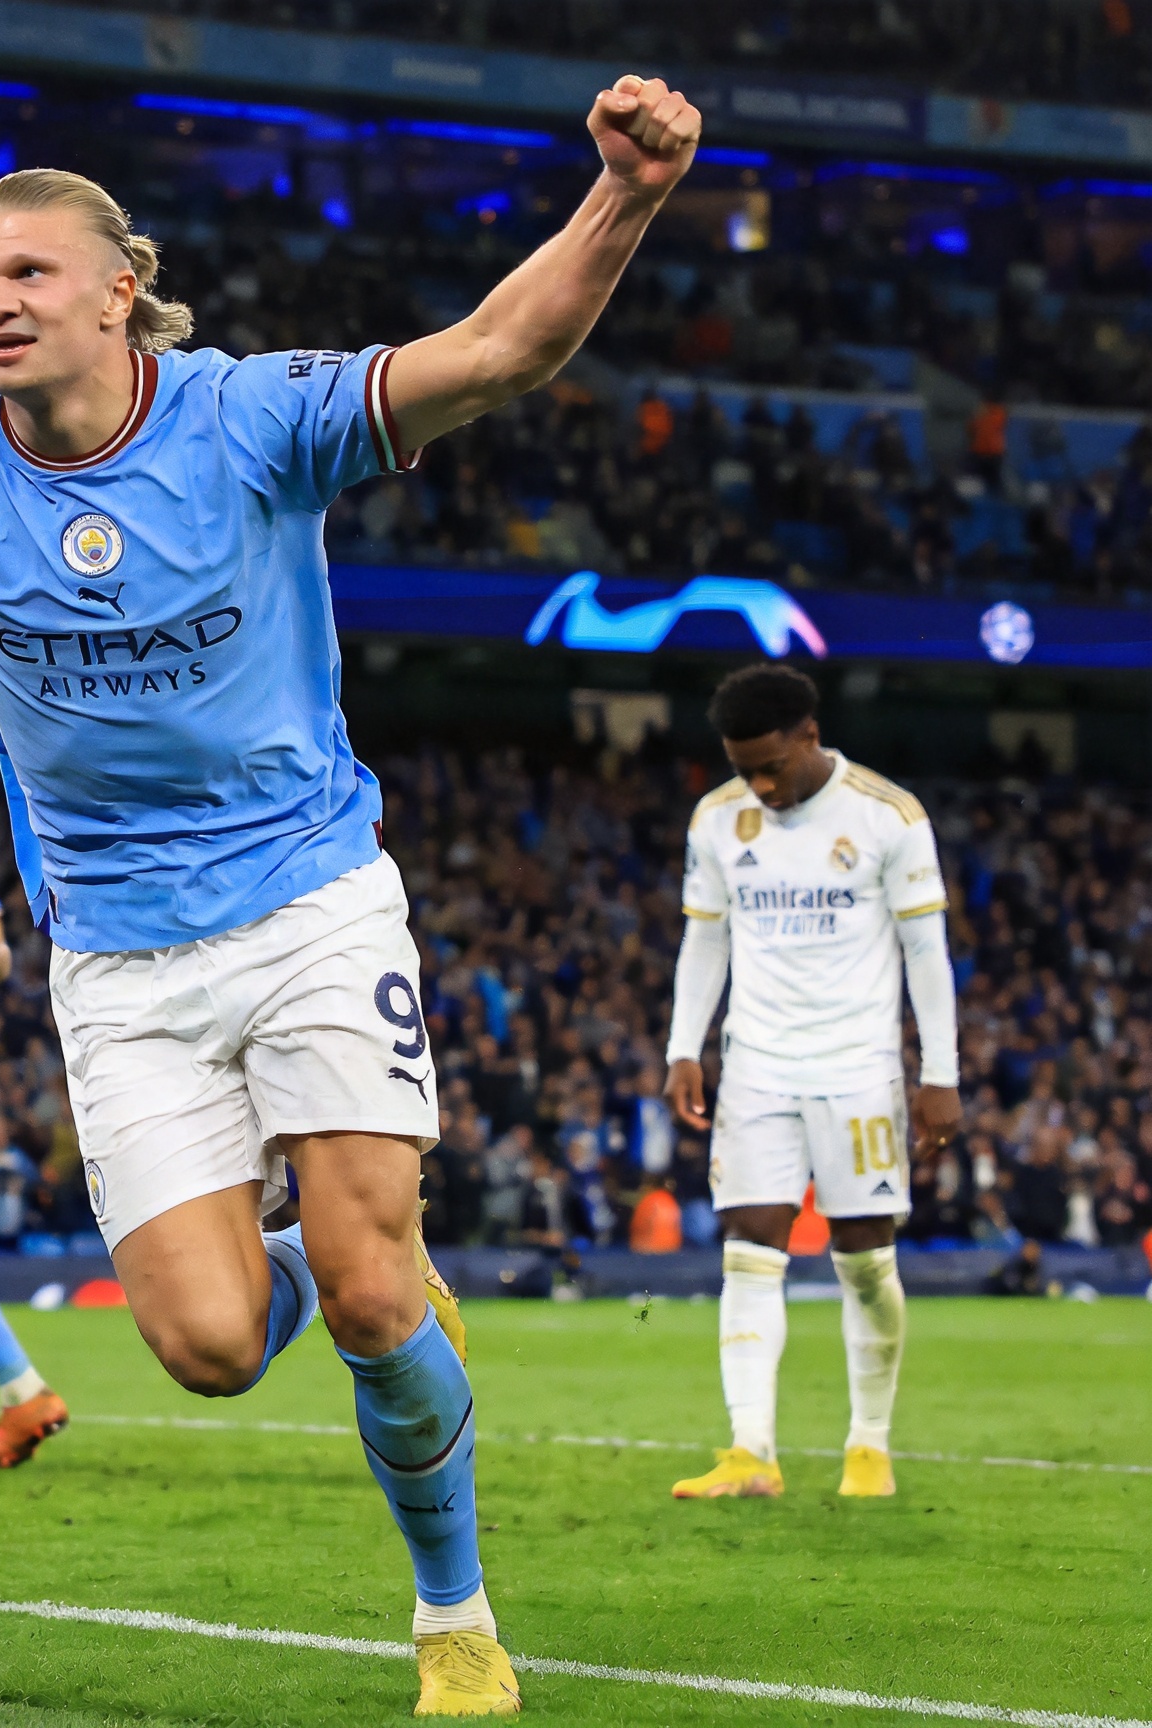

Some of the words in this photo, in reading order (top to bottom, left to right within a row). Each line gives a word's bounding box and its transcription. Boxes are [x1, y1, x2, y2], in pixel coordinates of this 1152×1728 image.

[39, 661, 207, 699] AIRWAYS
[737, 881, 855, 911] Emirates
[374, 971, 426, 1060] 9
[848, 1116, 897, 1176] 10
